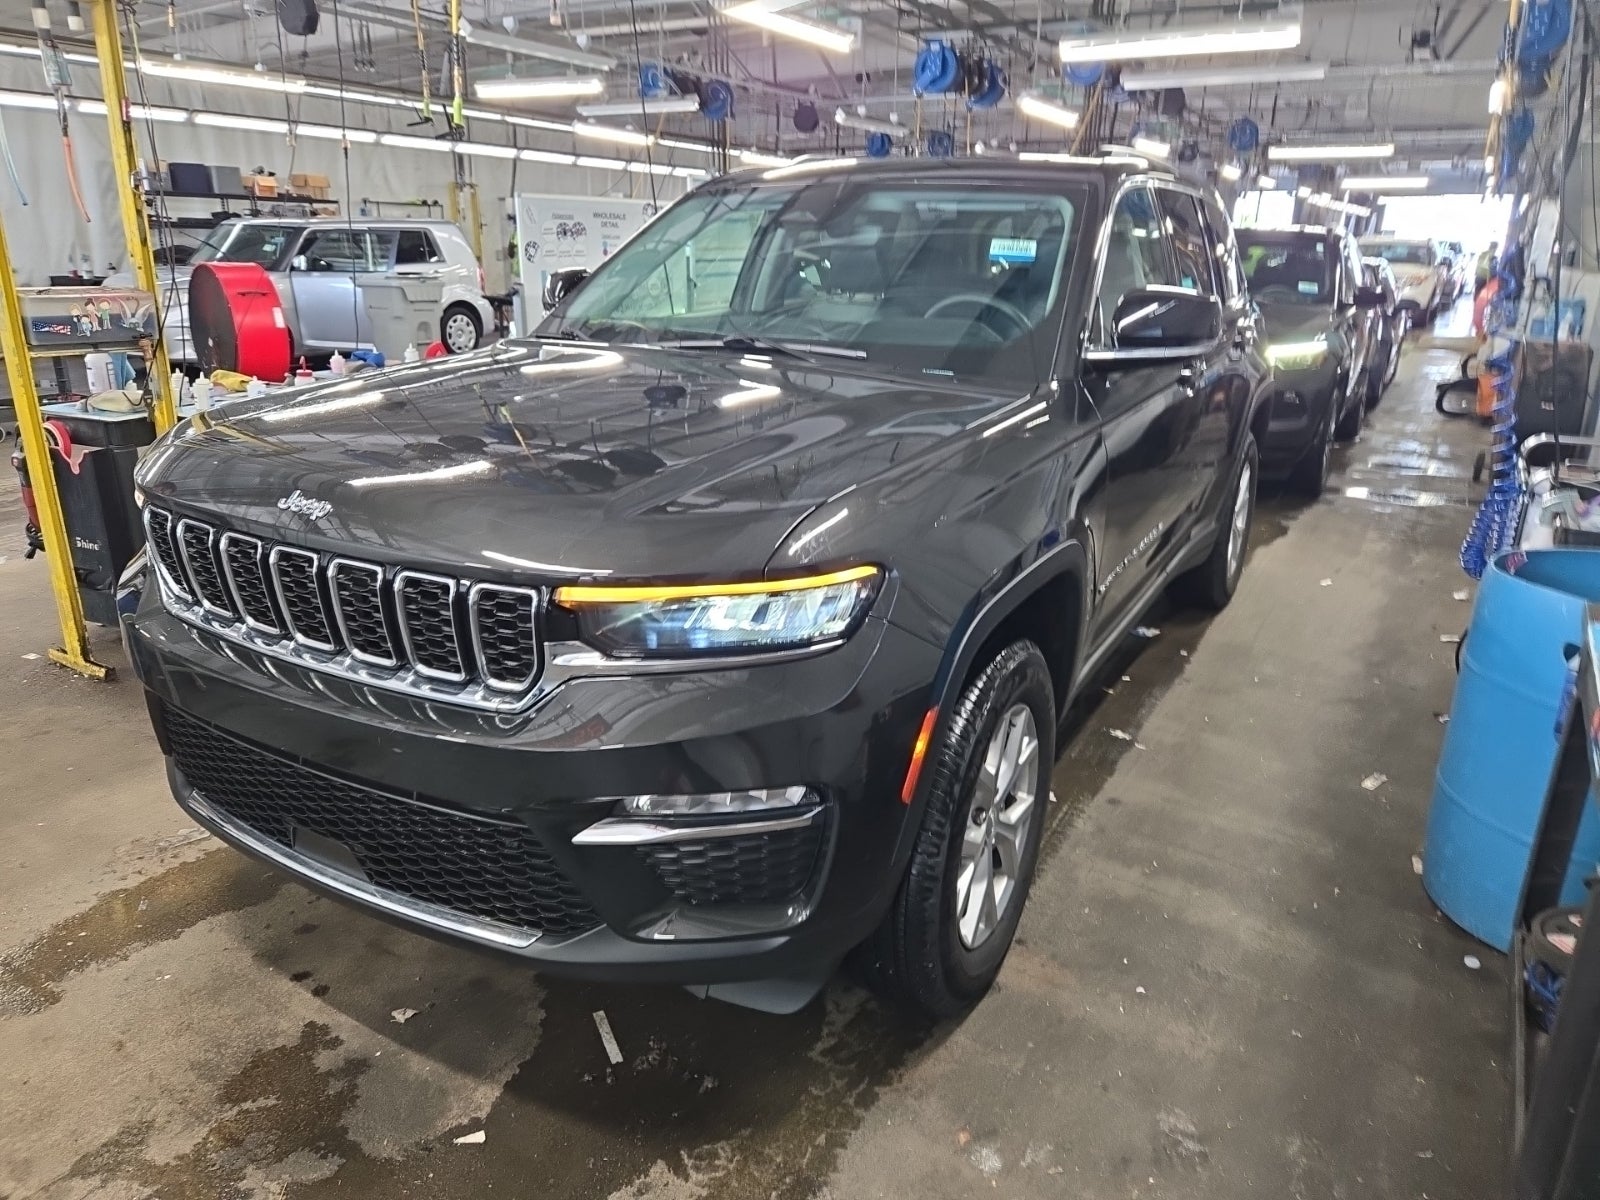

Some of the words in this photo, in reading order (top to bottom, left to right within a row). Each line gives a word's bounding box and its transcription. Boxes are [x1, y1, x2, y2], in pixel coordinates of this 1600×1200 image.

[592, 211, 627, 221] WHOLESALE
[600, 220, 620, 229] DETAIL
[277, 489, 334, 521] Jeep
